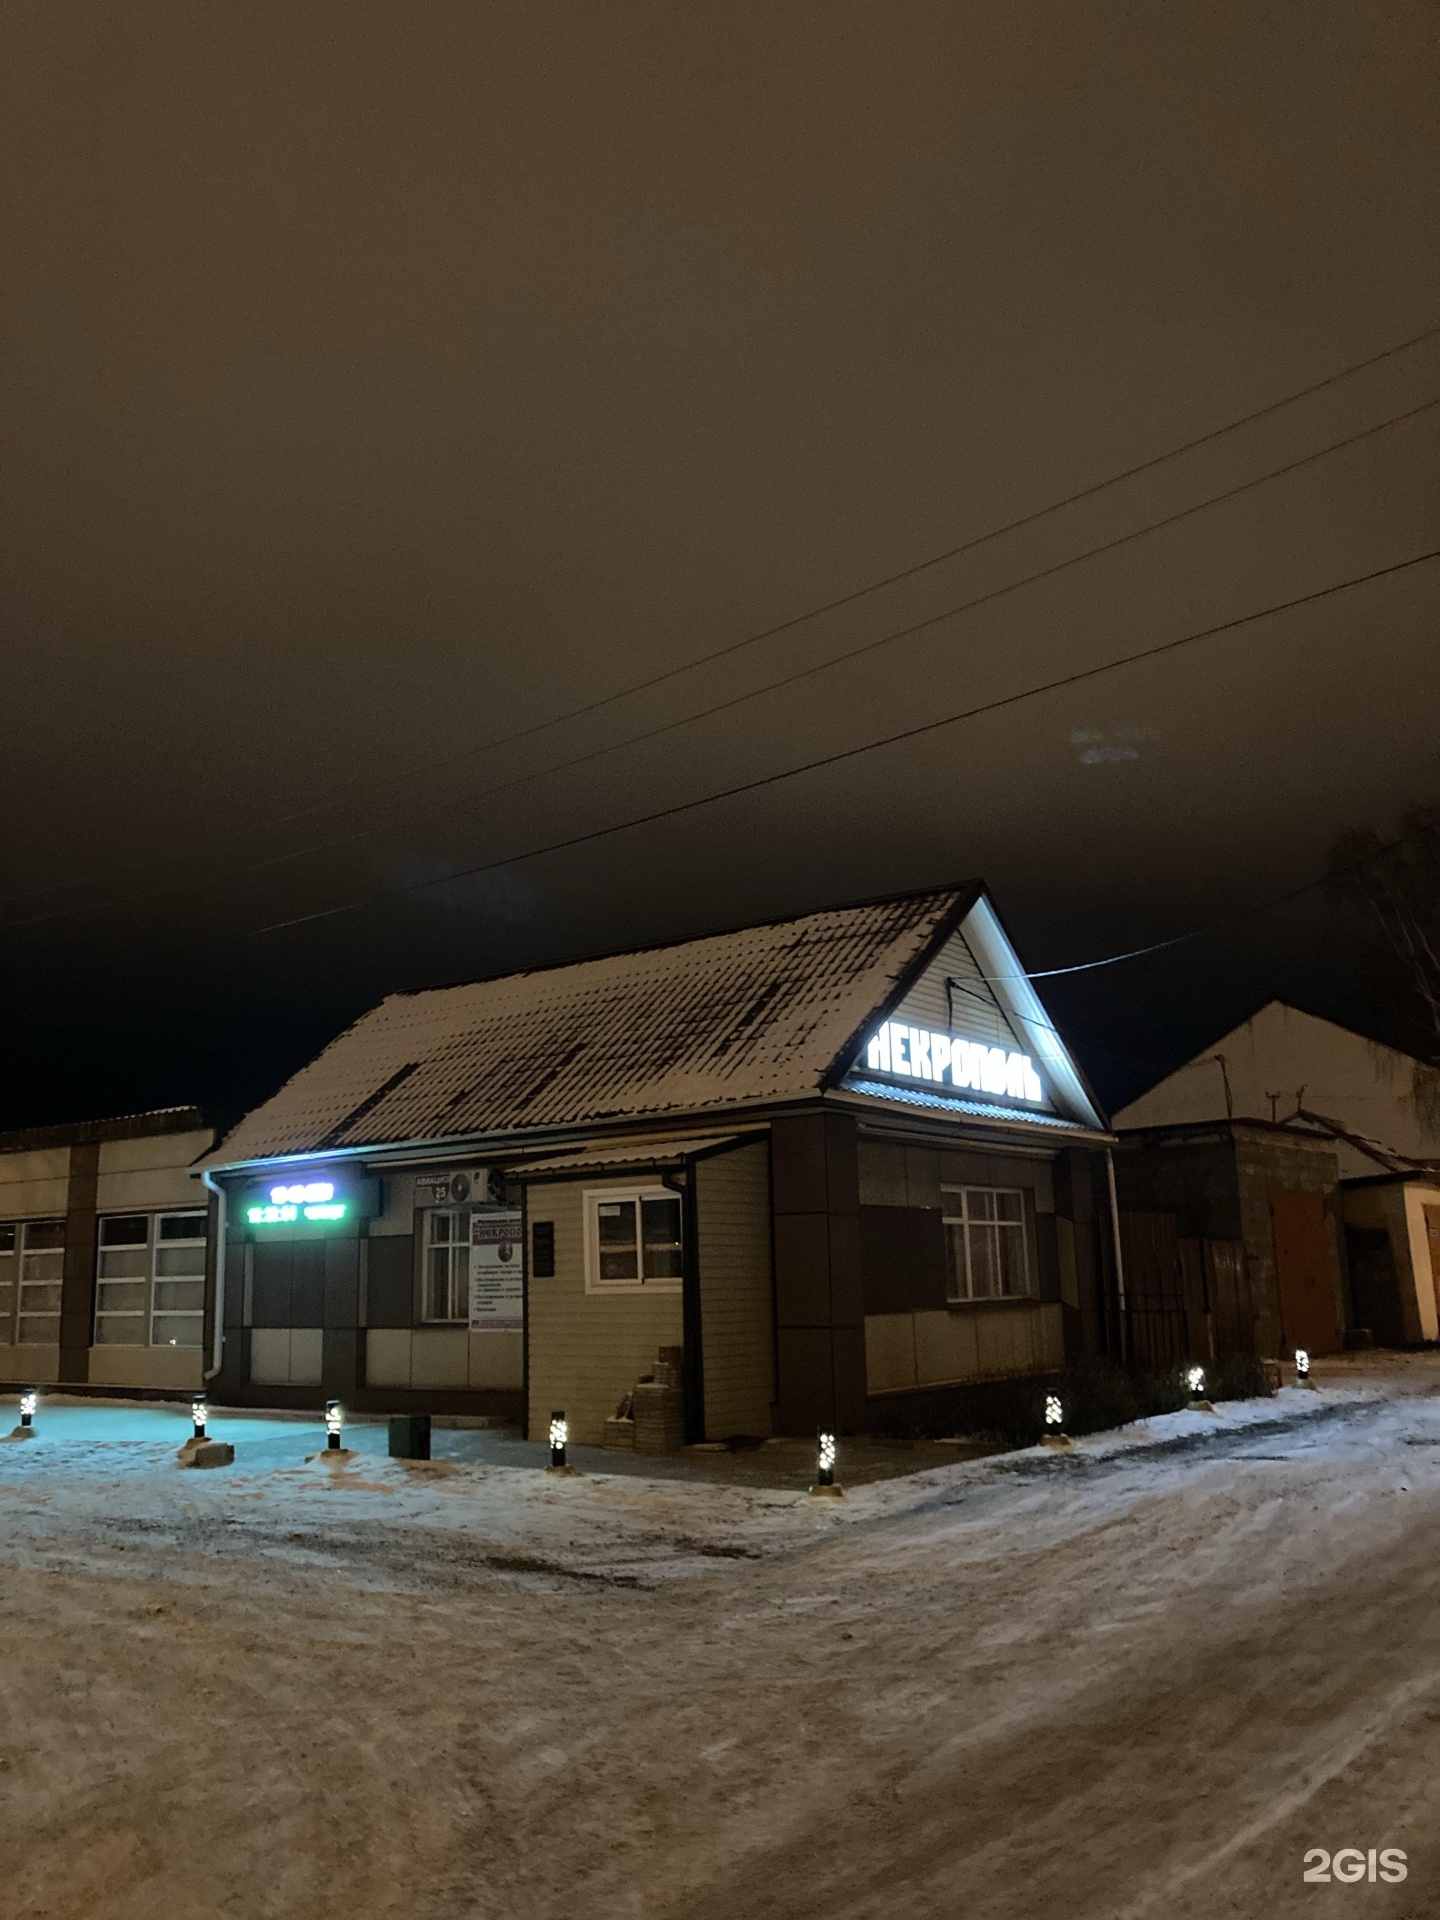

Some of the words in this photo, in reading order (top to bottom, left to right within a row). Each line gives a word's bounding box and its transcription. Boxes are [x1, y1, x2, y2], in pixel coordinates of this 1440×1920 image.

[868, 1021, 1042, 1102] НЕКРОПОЛЬ
[417, 1175, 449, 1185] АВИАЦИО
[435, 1187, 446, 1198] 25
